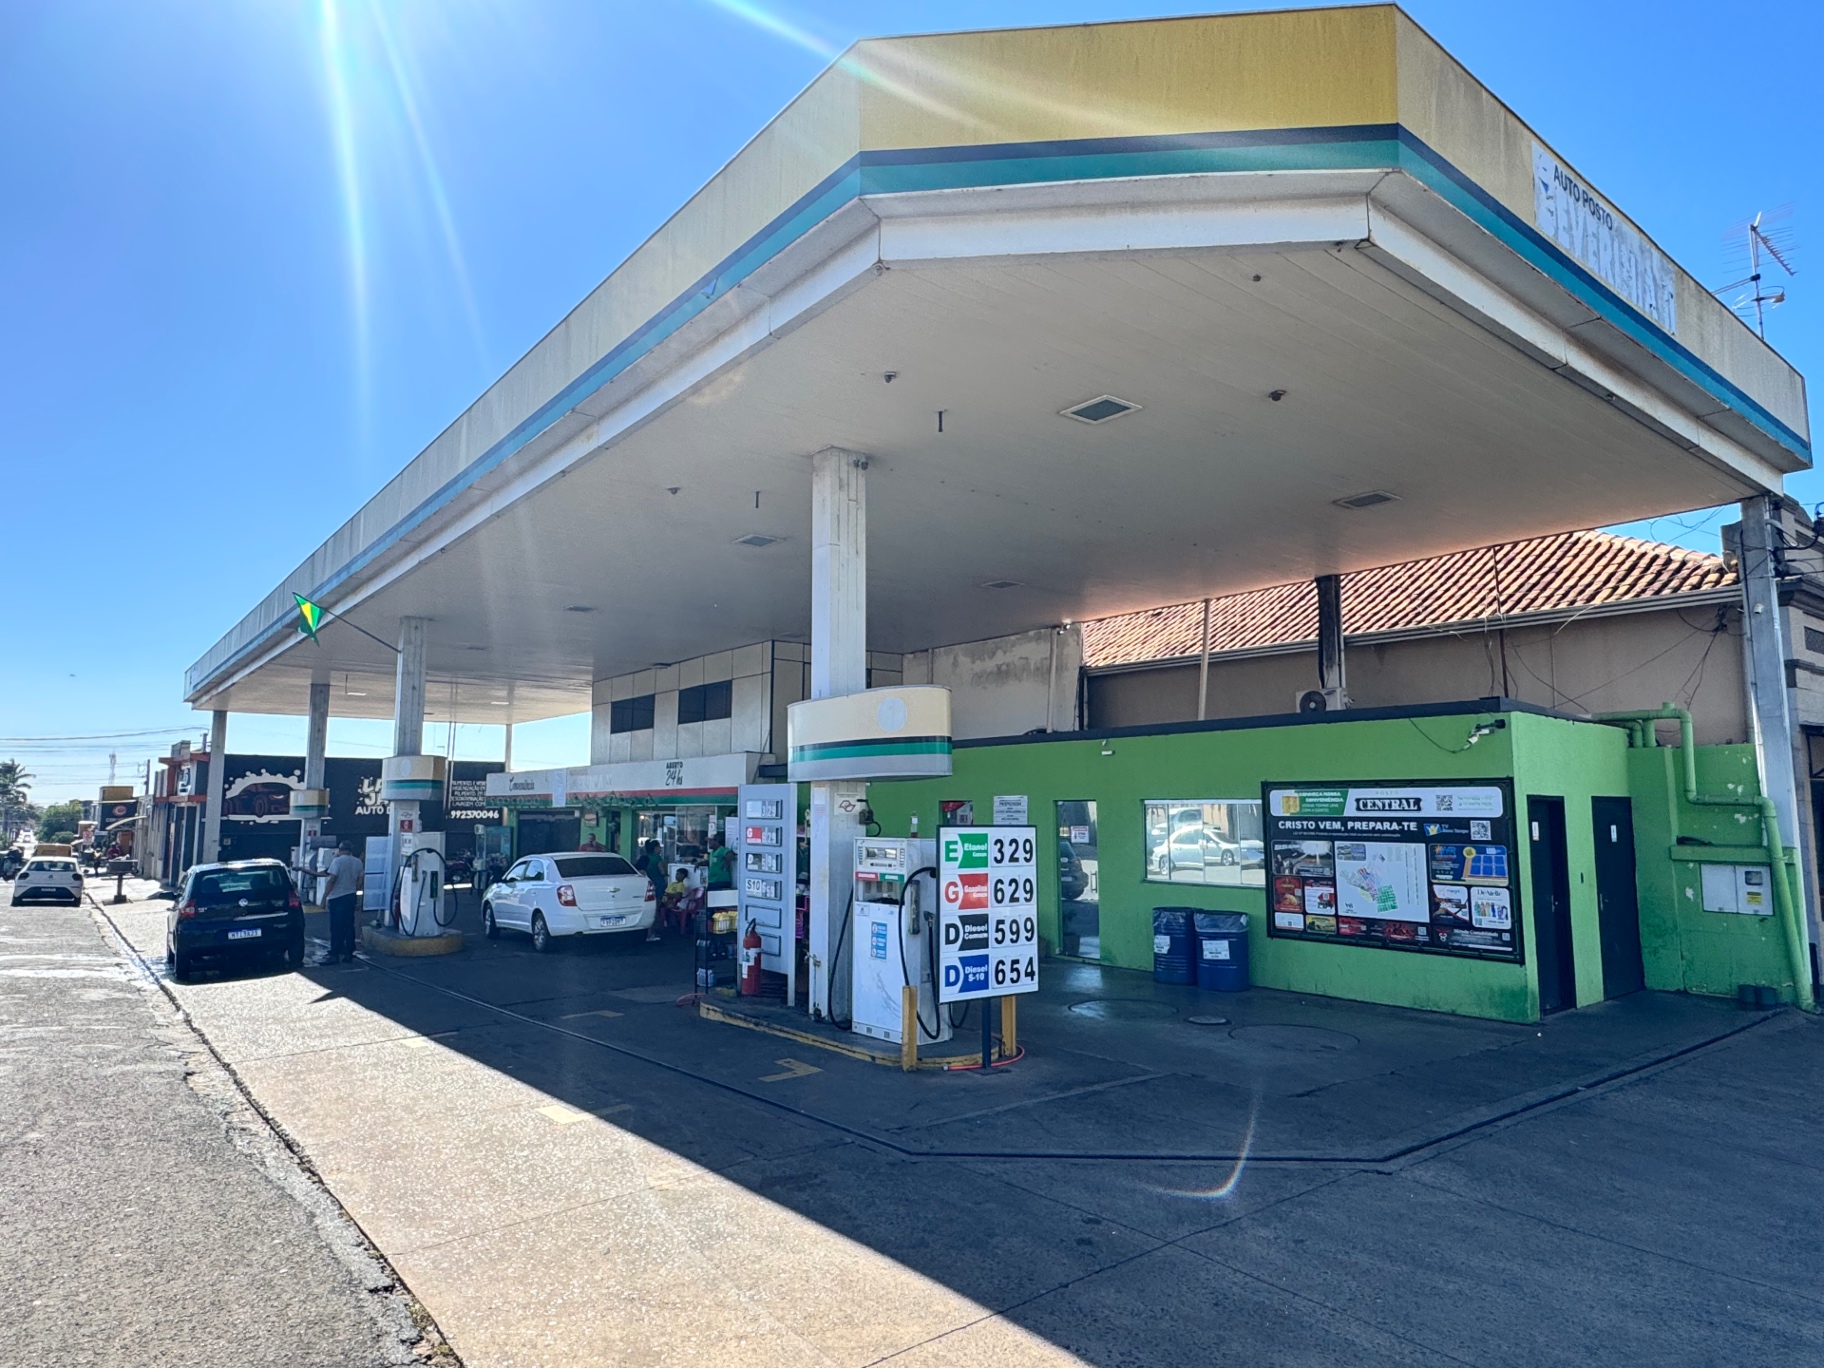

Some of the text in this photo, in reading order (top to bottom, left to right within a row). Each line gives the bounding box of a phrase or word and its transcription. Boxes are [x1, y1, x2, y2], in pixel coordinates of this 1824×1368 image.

[1553, 164, 1613, 231] AUTO POSTO
[355, 806, 384, 815] AUTO
[1359, 799, 1418, 811] CENTRAL
[1278, 820, 1418, 832] CRISTO VEM, PREPARA-TE
[746, 827, 753, 838] G
[945, 841, 959, 862] E
[963, 843, 988, 851] Etanol
[993, 838, 1034, 864] 329
[747, 854, 754, 864] D
[747, 880, 761, 891] S10
[993, 878, 1034, 904] 629
[944, 881, 959, 903] G
[964, 923, 988, 932] Diesel
[994, 917, 1035, 945] 599
[945, 923, 960, 945] D
[964, 932, 988, 940] Comum
[964, 964, 988, 974] Diesel
[994, 956, 1036, 985] 654
[945, 965, 960, 988] D
[968, 973, 985, 982] S-10
